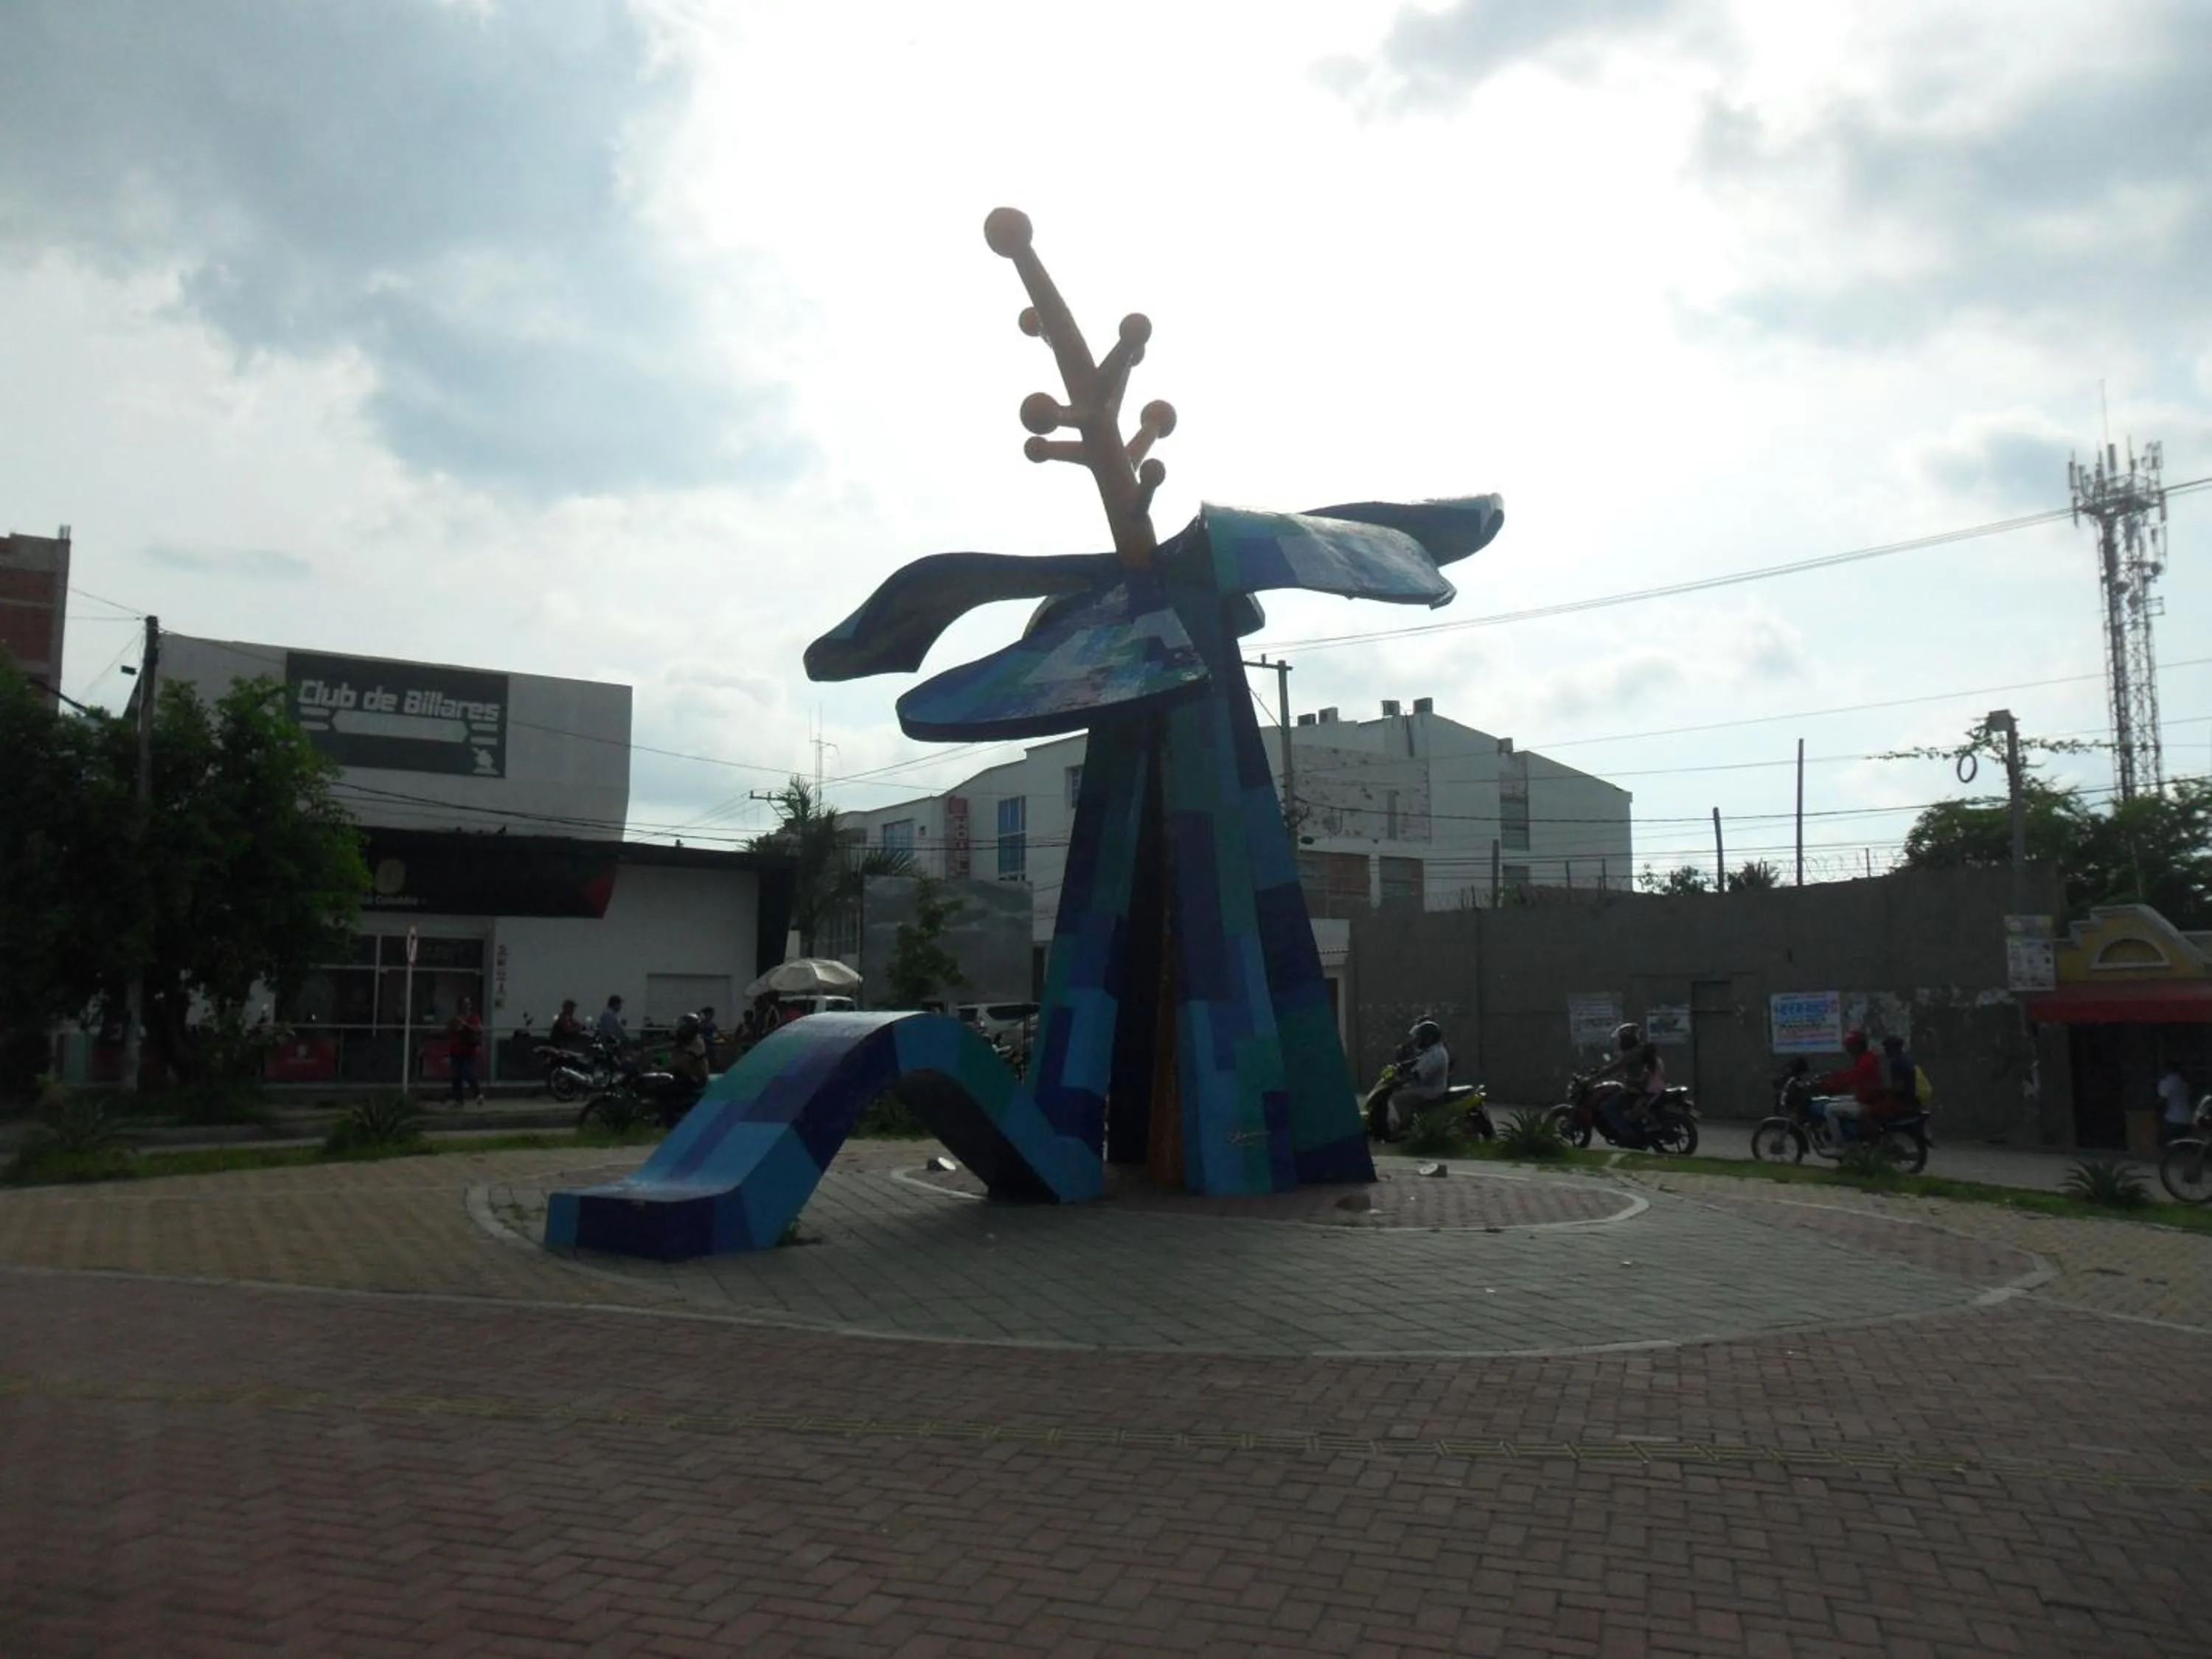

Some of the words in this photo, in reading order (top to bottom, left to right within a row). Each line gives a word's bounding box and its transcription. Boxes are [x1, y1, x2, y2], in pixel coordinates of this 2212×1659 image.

[297, 679, 358, 708] Club
[363, 685, 398, 712] de
[403, 689, 501, 722] Billares
